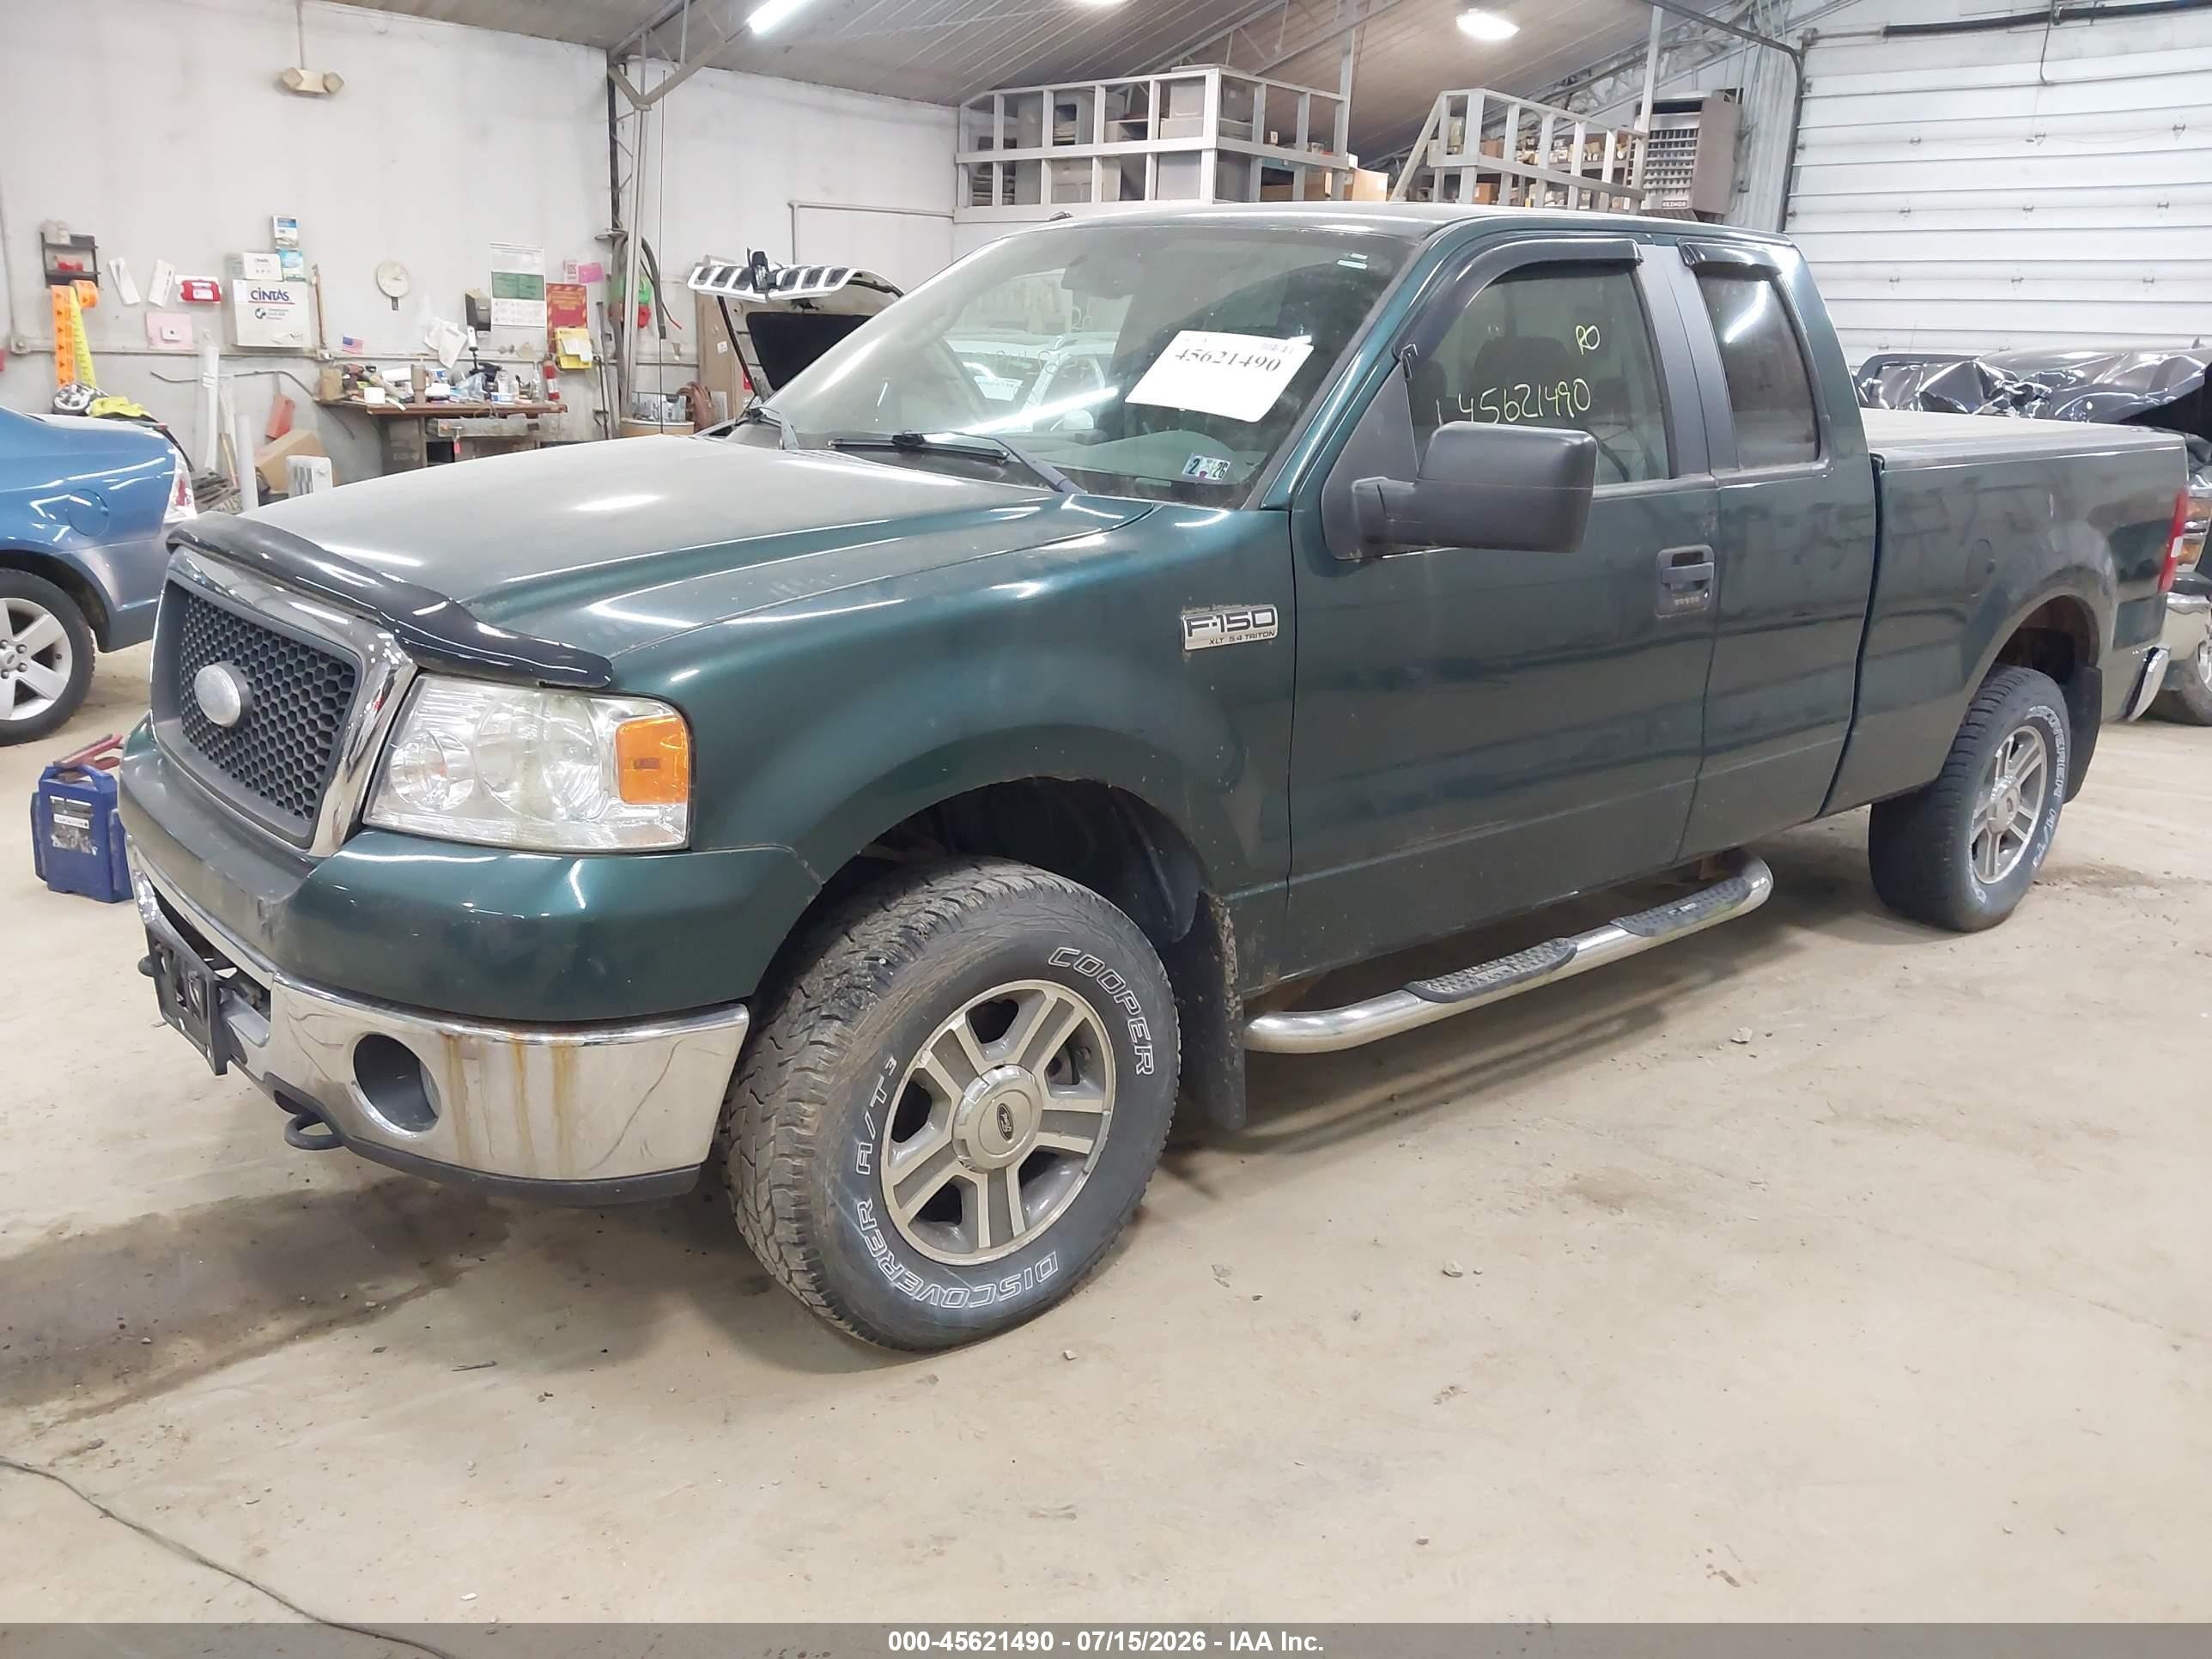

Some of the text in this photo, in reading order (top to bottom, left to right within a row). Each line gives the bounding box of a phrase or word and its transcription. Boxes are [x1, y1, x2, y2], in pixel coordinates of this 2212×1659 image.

[1175, 348, 1282, 372] 45621490
[1457, 378, 1591, 425] 45621490
[1212, 461, 1229, 478] 26
[1184, 608, 1277, 638] F-150
[1209, 637, 1224, 646] XLT
[1245, 629, 1276, 641] TRITON
[1048, 945, 1156, 1077] COOPER
[855, 1200, 1060, 1310] DISCOVERER
